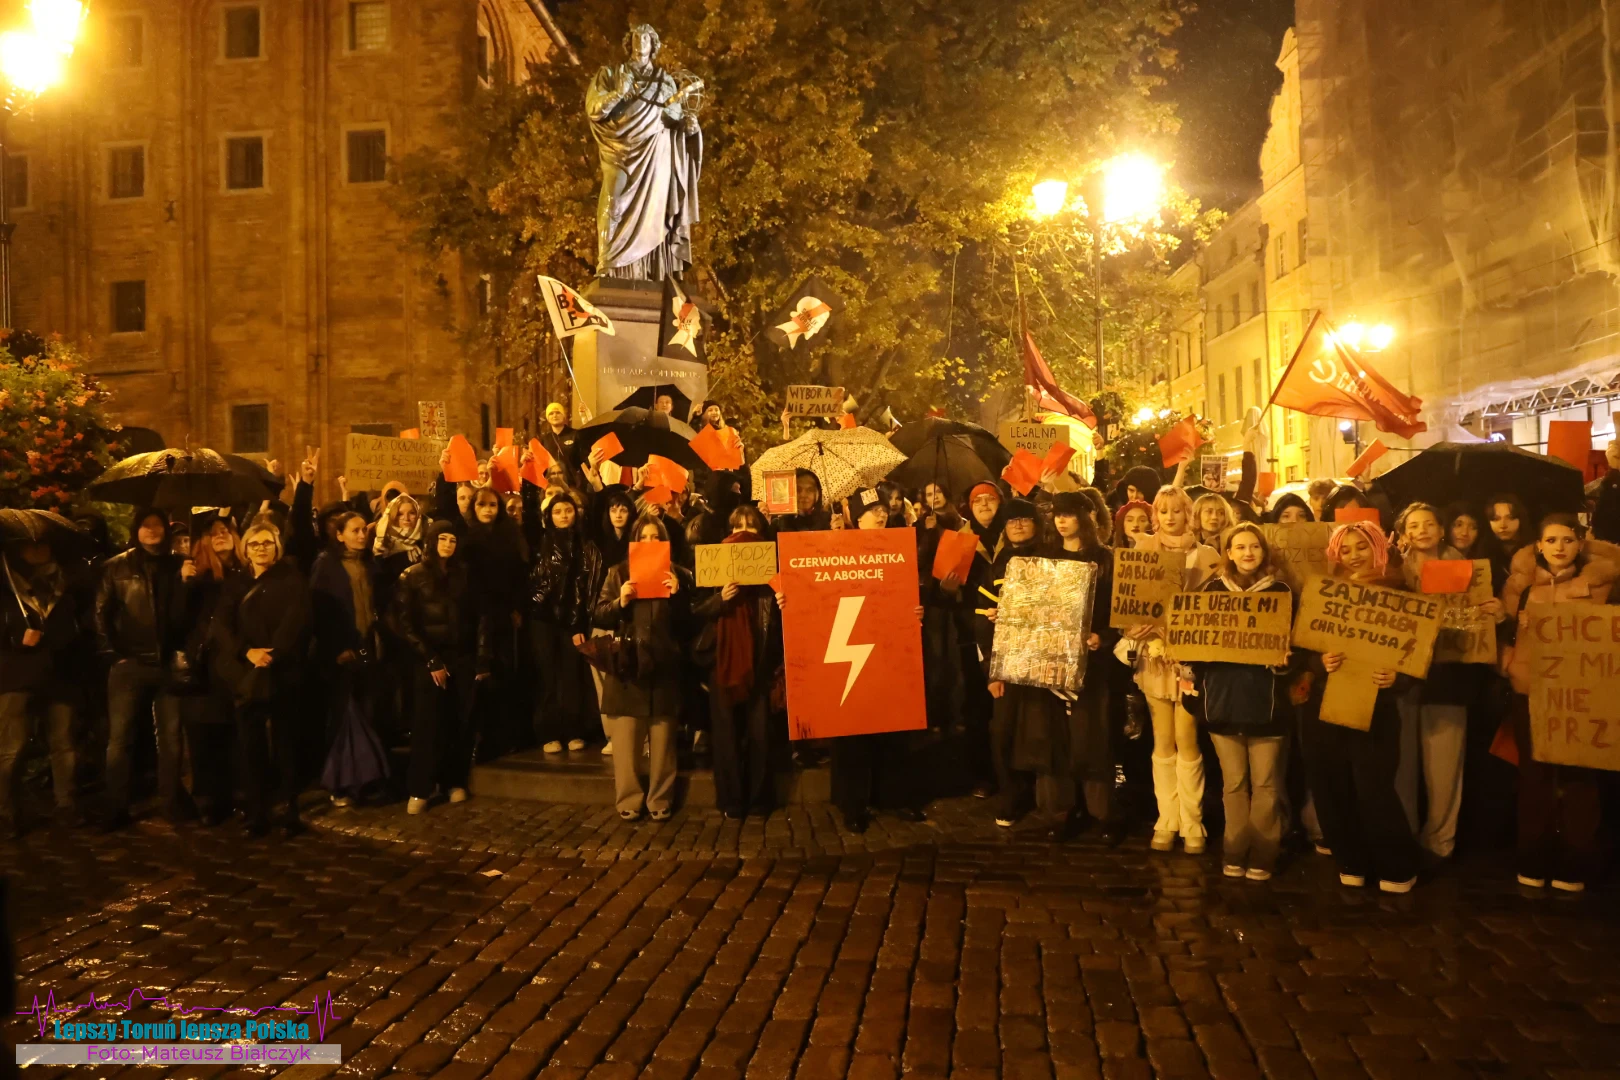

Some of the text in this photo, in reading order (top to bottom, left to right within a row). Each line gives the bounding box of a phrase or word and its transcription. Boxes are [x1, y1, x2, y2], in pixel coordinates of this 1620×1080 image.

[825, 388, 832, 398] A
[788, 402, 838, 415] NIE ZAKAZ
[1010, 427, 1057, 438] LEGALNA
[352, 437, 368, 449] WY
[350, 469, 383, 480] PRZEZ
[700, 547, 721, 563] MY
[789, 553, 905, 568] CZERWONA KARTKA
[699, 563, 776, 583] MY CHOICE
[814, 569, 884, 582] ZA ABORCJĘ
[1118, 582, 1136, 596] NIE
[1173, 594, 1278, 613] NIE UFACIE MI
[1319, 579, 1438, 619] ZAJMIJCIE
[1322, 601, 1353, 622] SIĘ
[1170, 614, 1180, 626] Z
[1247, 615, 1257, 628] A
[1169, 629, 1210, 645] UFACIE
[1211, 631, 1220, 645] Z
[1540, 656, 1564, 679] Z
[1547, 687, 1592, 713] NIE
